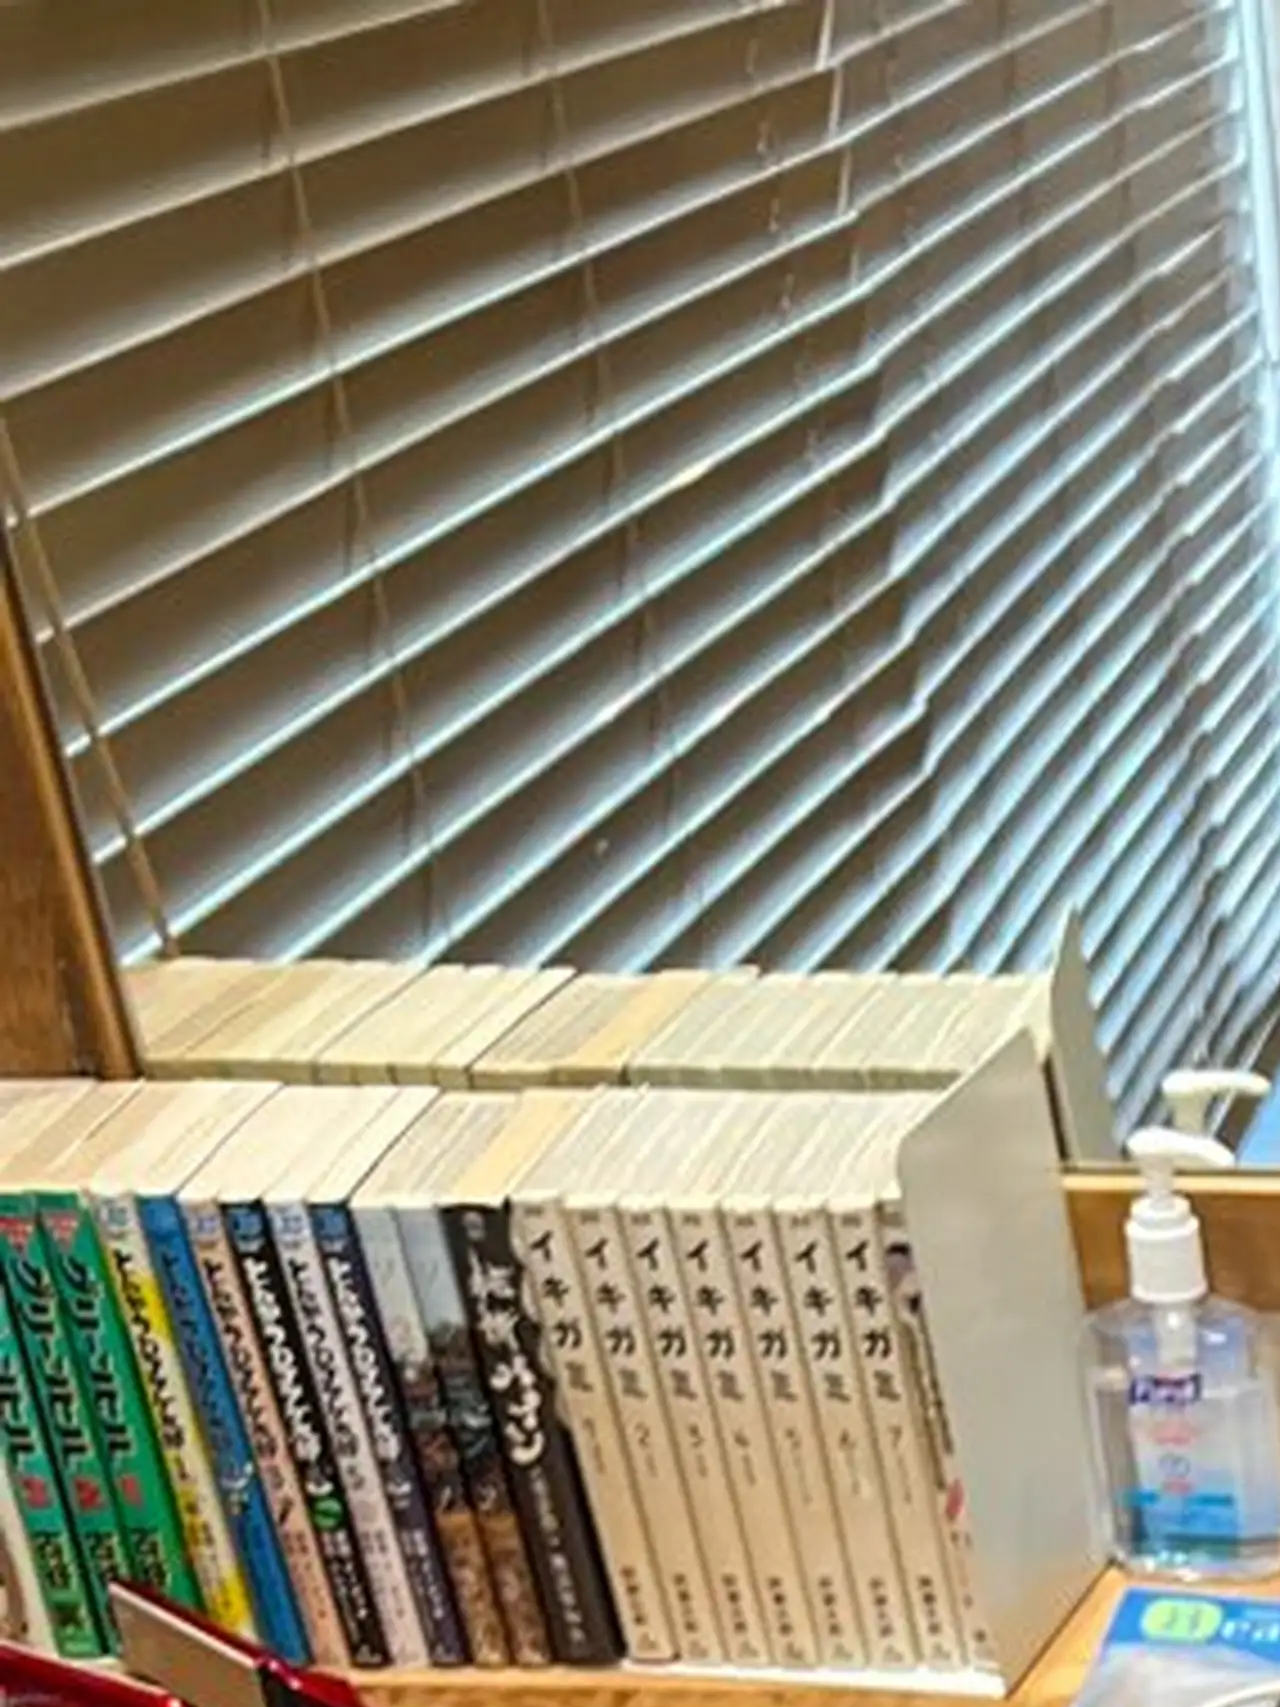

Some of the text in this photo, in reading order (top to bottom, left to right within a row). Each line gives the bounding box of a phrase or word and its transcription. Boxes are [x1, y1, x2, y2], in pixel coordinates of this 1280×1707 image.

[11, 1255, 88, 1467] グリーンヒル
[58, 1251, 132, 1464] グリーンヒル
